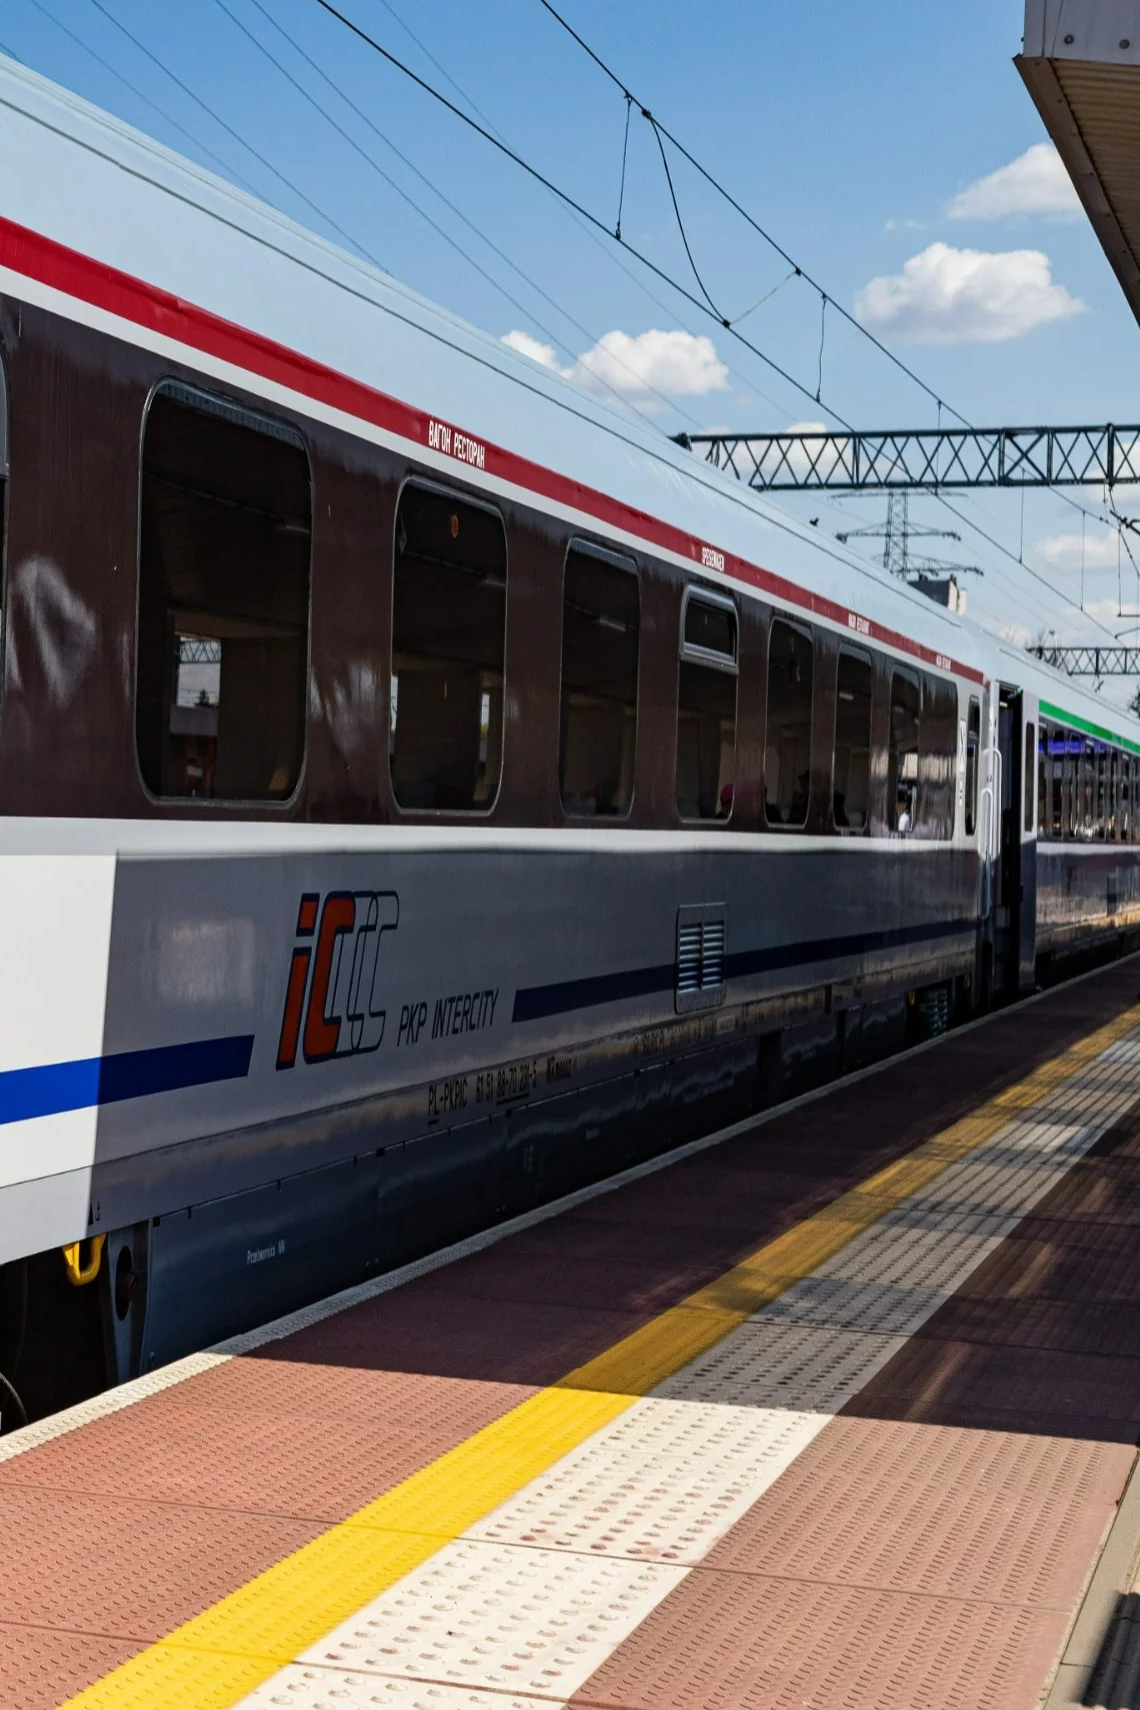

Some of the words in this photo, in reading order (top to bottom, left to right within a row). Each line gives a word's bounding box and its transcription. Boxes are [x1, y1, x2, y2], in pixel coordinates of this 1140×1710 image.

[428, 420, 451, 454] ВАГОН
[453, 432, 485, 469] РЕСТОРАН
[397, 1001, 428, 1047] PKP
[431, 988, 500, 1039] INTERCITY
